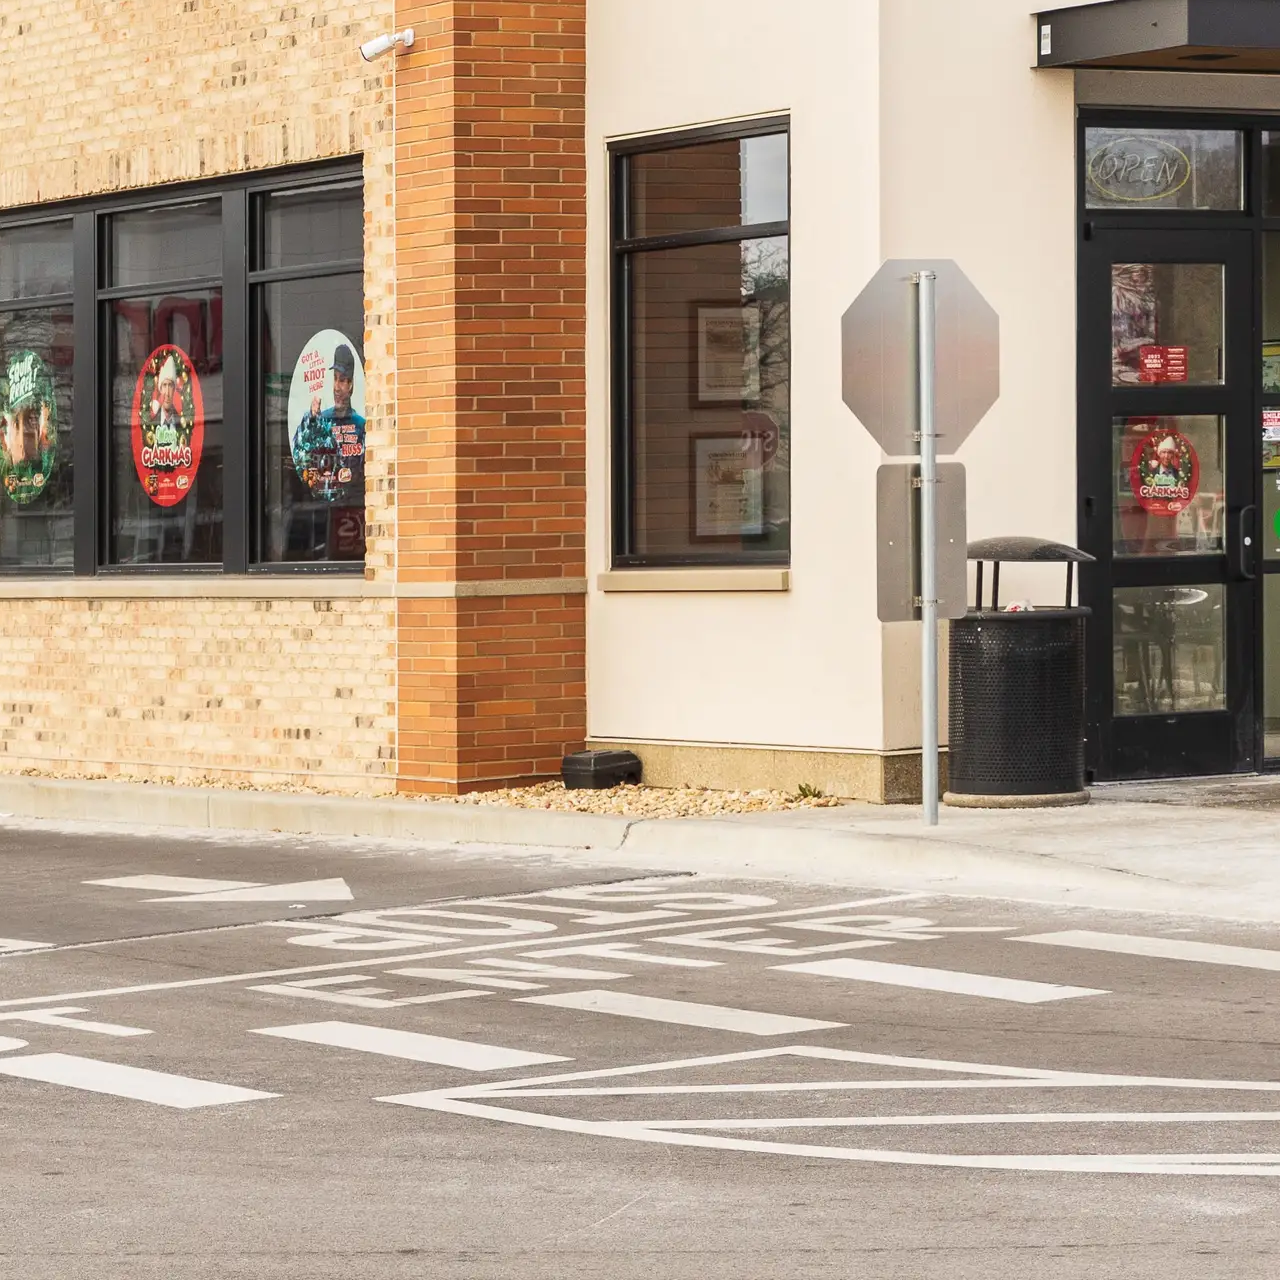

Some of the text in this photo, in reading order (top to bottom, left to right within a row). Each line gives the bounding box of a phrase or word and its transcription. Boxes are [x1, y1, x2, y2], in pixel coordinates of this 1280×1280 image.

[1099, 152, 1180, 184] OPEN
[303, 367, 326, 383] KNOT
[141, 444, 192, 468] CLARKMAS
[341, 443, 363, 457] RUSS
[1140, 485, 1190, 499] CLARKMAS
[265, 884, 779, 951] STOP
[245, 913, 1022, 1010] ENTER
